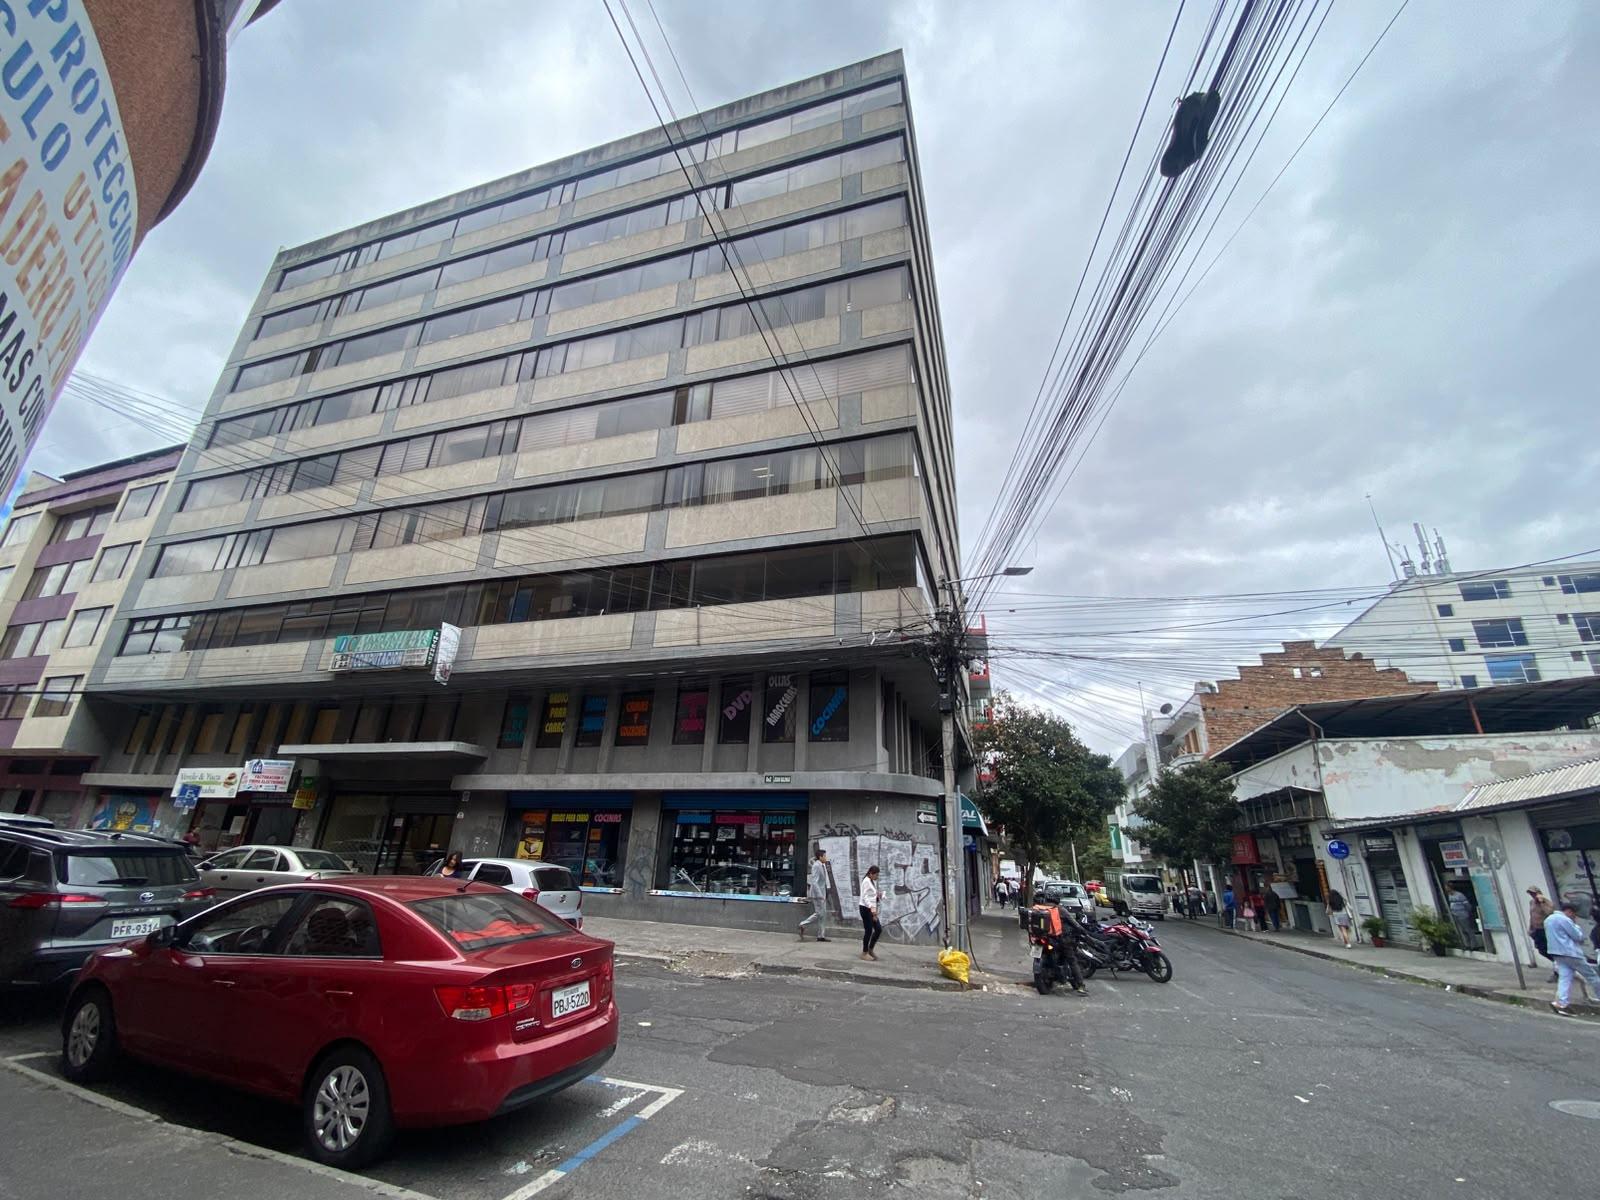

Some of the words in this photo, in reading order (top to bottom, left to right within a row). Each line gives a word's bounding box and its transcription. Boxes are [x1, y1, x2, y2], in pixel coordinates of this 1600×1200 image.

[722, 689, 752, 721] DVD
[594, 813, 622, 822] COCINAS
[554, 991, 589, 1016] PBJ-5220
